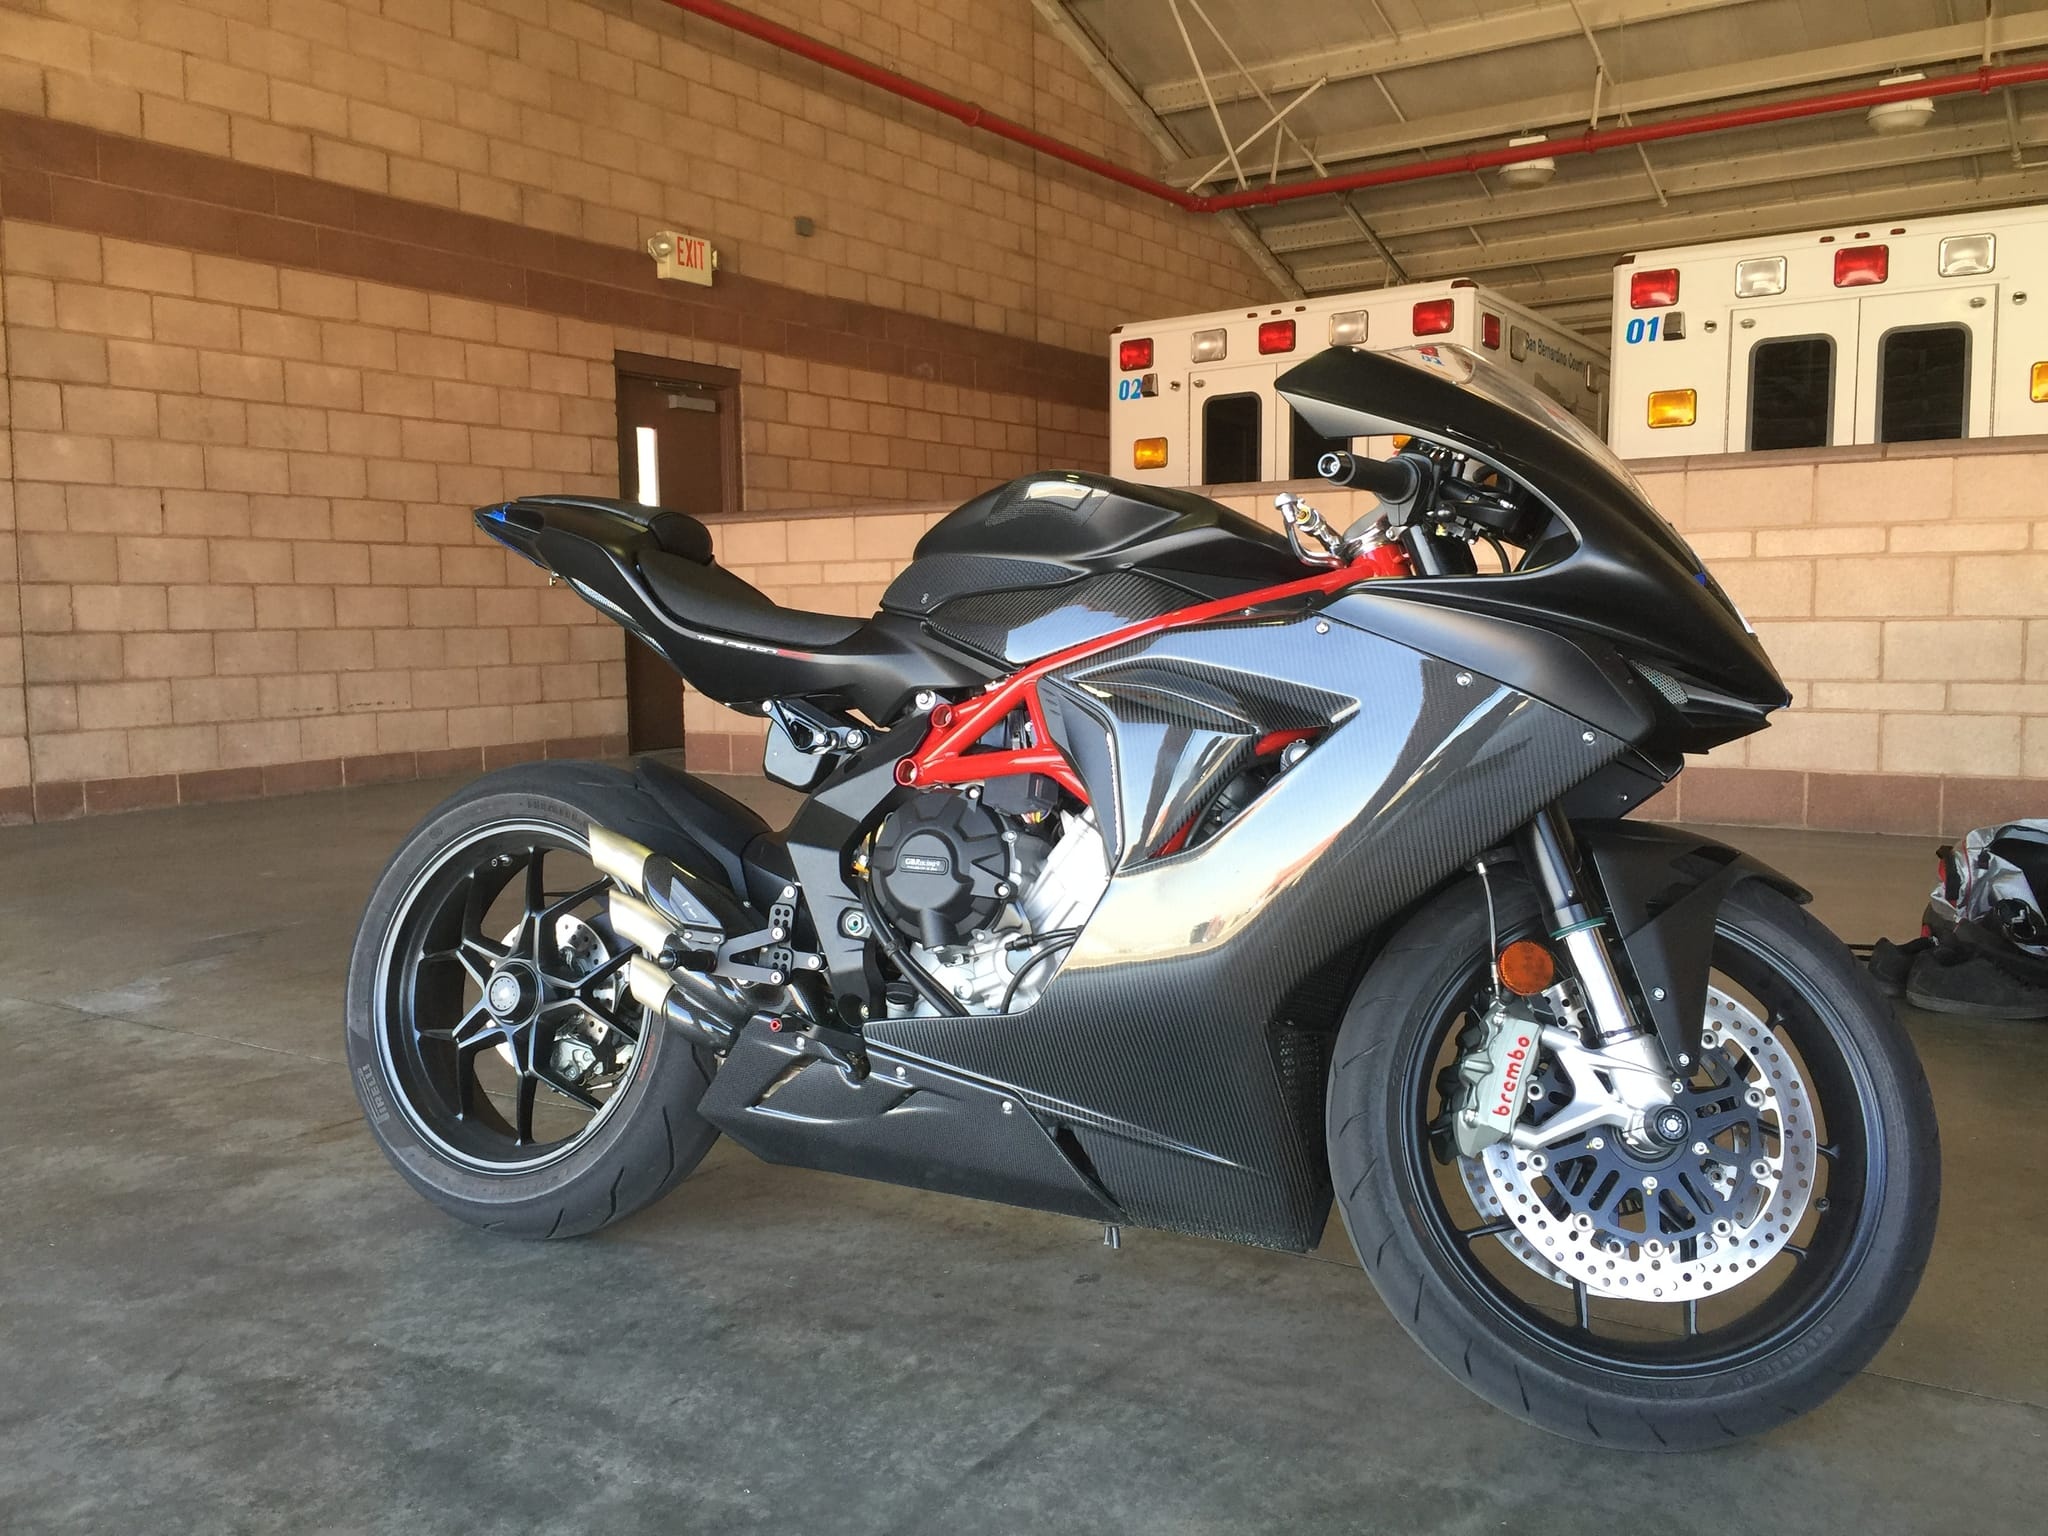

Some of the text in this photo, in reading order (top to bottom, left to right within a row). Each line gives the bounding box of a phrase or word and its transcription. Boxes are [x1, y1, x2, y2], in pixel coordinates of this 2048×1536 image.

[677, 236, 704, 270] EXIT
[1626, 316, 1660, 344] 01
[1538, 338, 1567, 367] Bernardino
[1118, 378, 1142, 400] 02
[1491, 1035, 1532, 1117] brembo
[357, 1063, 391, 1124] PIRELLI
